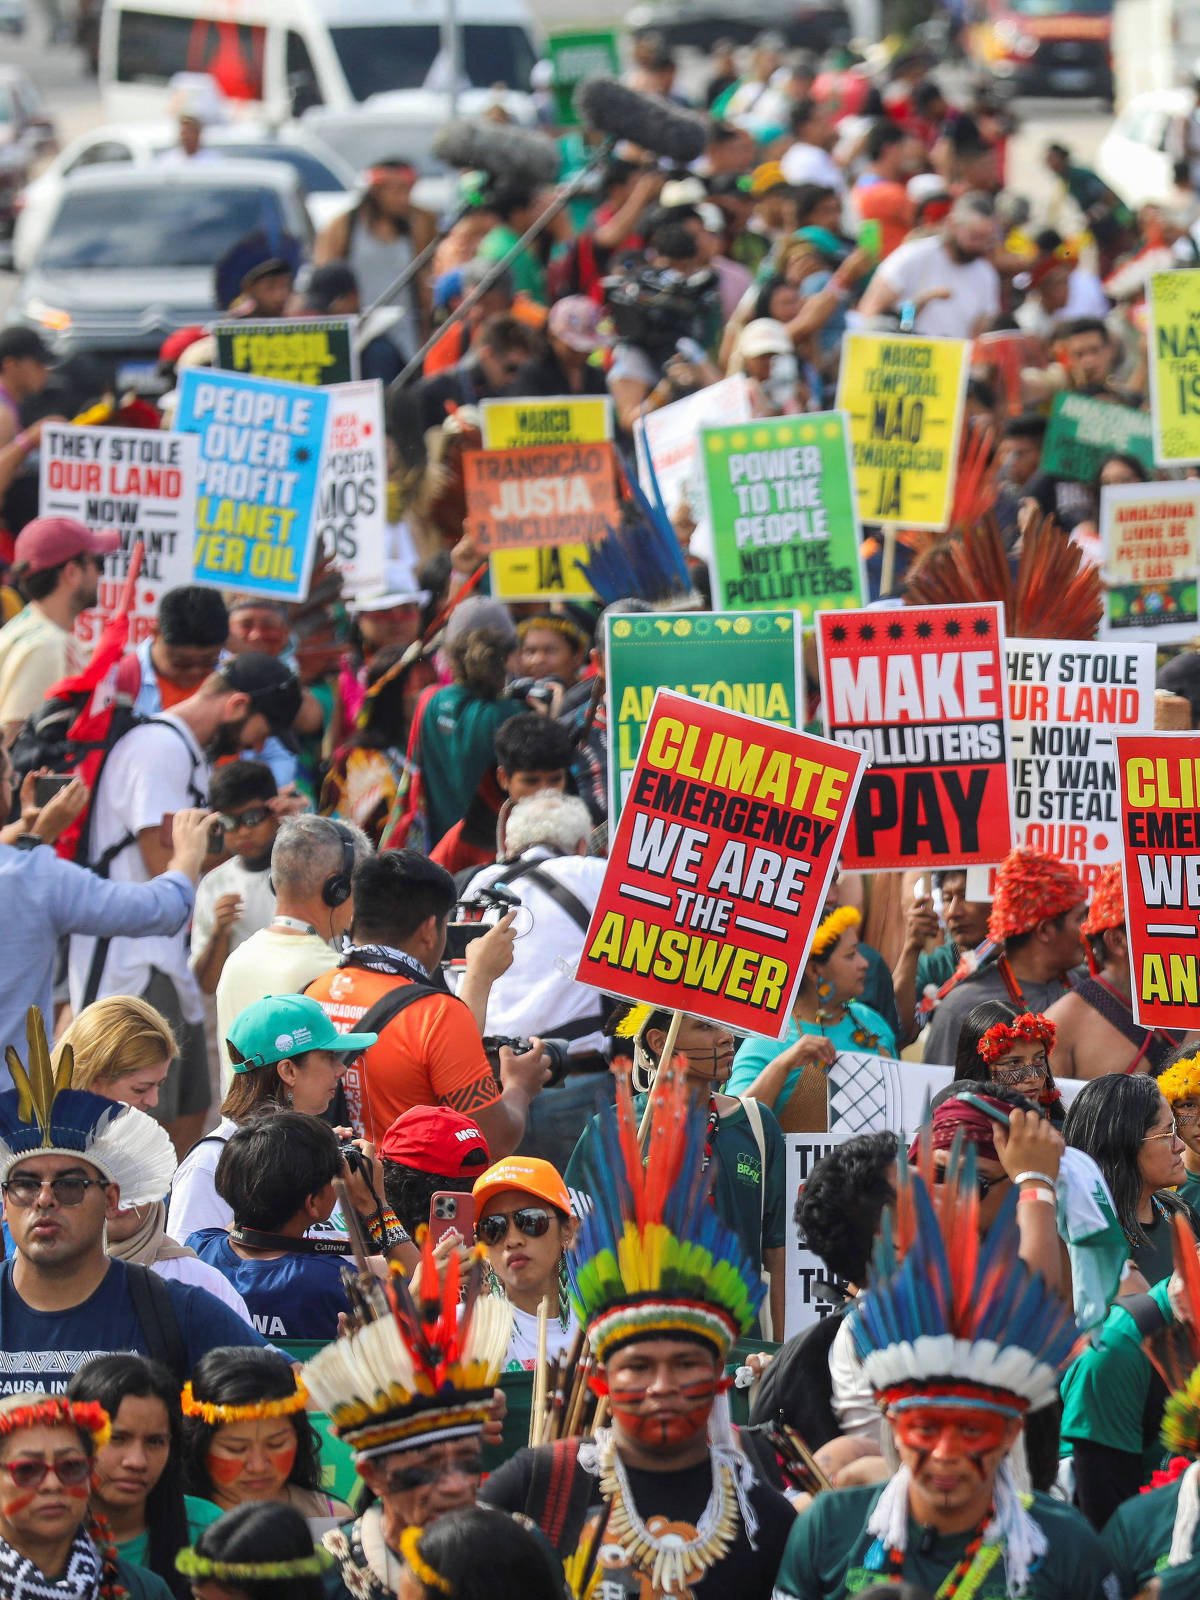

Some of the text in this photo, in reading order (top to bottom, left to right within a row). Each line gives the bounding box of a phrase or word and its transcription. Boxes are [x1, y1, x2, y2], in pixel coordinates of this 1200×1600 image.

[193, 384, 314, 436] PEOPLE
[48, 432, 181, 464] THEY STOLE
[204, 423, 292, 467] OVER
[727, 445, 824, 486] POWER
[47, 459, 183, 499] OUR LAND
[489, 475, 596, 521] JUSTA
[732, 476, 824, 517] TO THE
[85, 499, 139, 524] NOW
[733, 506, 831, 550] PEOPLE
[250, 543, 297, 583] OIL
[737, 540, 832, 577] NOT THE
[724, 567, 854, 606] POLLUTERS
[829, 650, 998, 724] MAKE
[1008, 651, 1139, 685] HEY STOLE
[1010, 683, 1140, 724] UR LAND
[1030, 726, 1091, 757] NOW
[646, 716, 849, 821] CLIMATE
[632, 767, 835, 858] EMERGENCY
[856, 768, 990, 858] PAY
[1038, 791, 1118, 822] STEAL
[1025, 823, 1088, 861] OUR
[626, 811, 812, 917] WE ARE
[674, 887, 736, 938] THE
[586, 909, 790, 1014] ANSWER
[454, 1127, 481, 1142] MST
[314, 1242, 346, 1252] Canon
